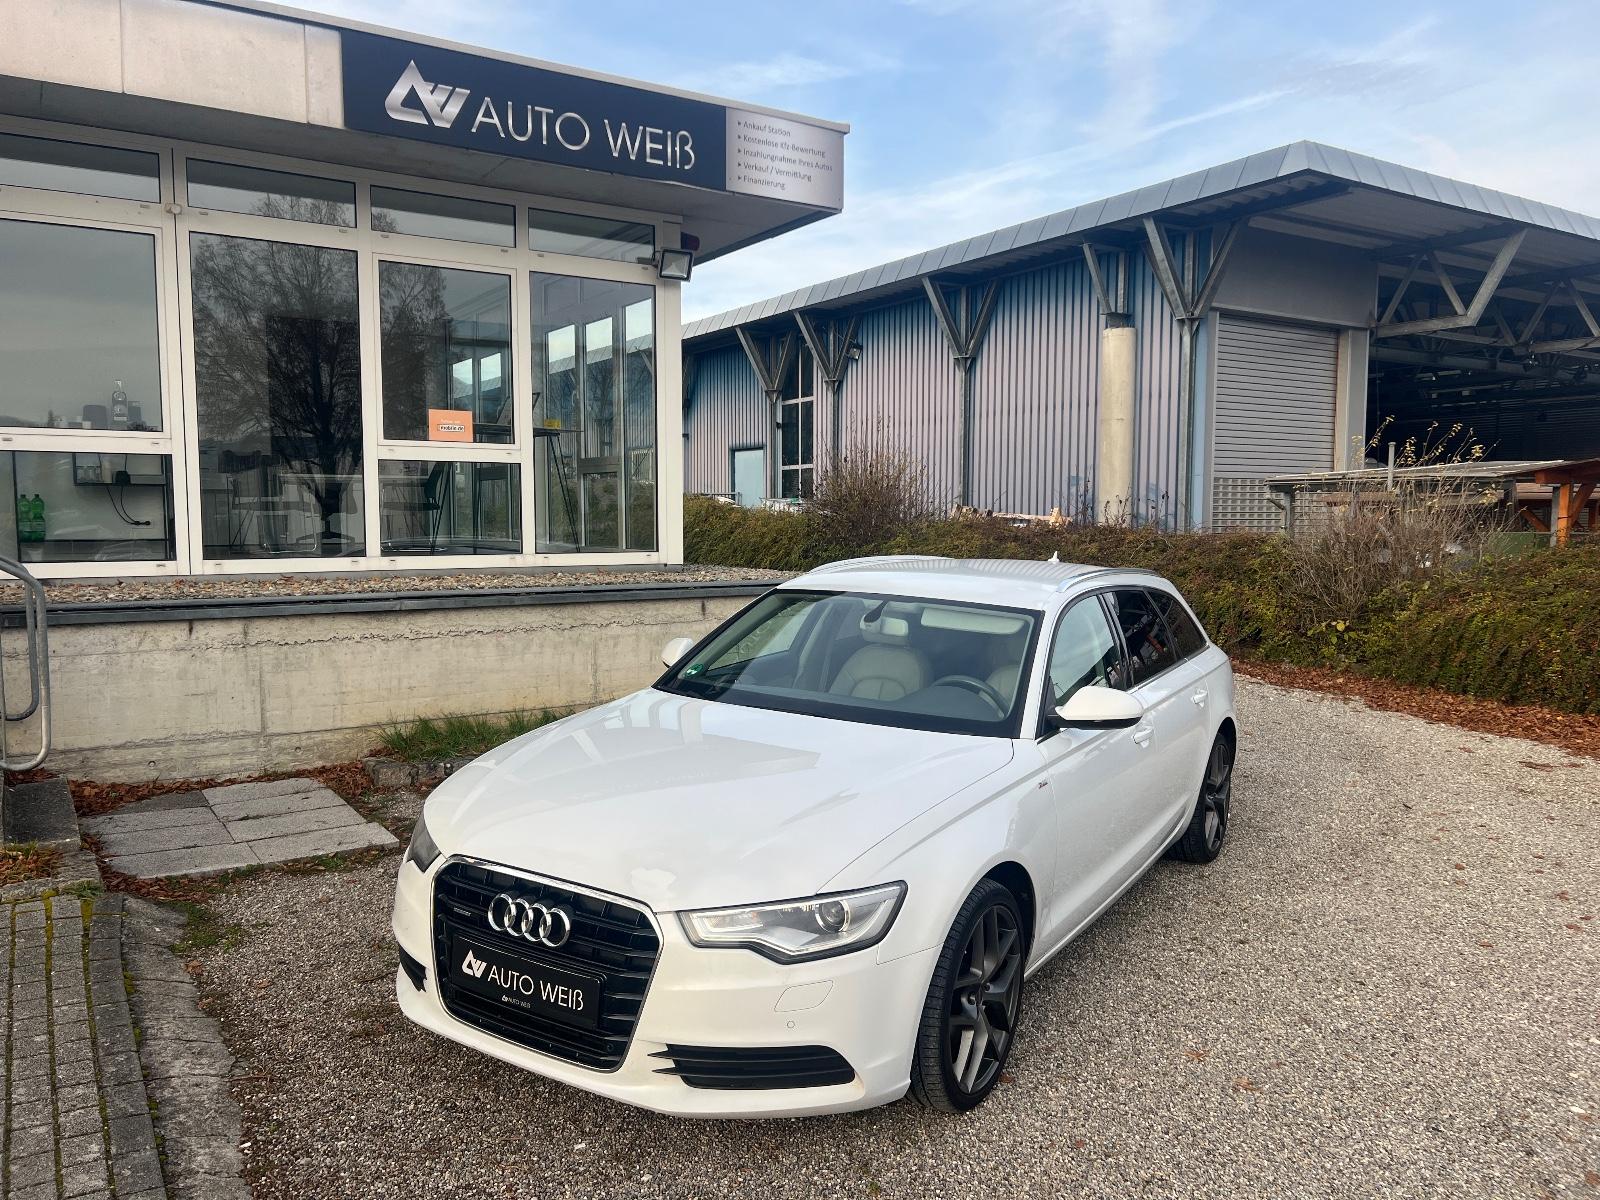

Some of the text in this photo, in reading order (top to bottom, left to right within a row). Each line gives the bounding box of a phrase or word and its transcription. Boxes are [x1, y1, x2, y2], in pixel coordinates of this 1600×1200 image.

[471, 96, 695, 170] AUTO WEIß
[743, 121, 791, 137] Ankauf Station
[743, 134, 779, 148] Kostenlose
[743, 148, 833, 172] Inzahlungnahme Ihres Autos
[743, 161, 769, 172] Verkauf
[775, 167, 812, 183] Vermittlung
[743, 175, 786, 191] Finanzierung
[487, 965, 584, 1011] AUTO WEIß
